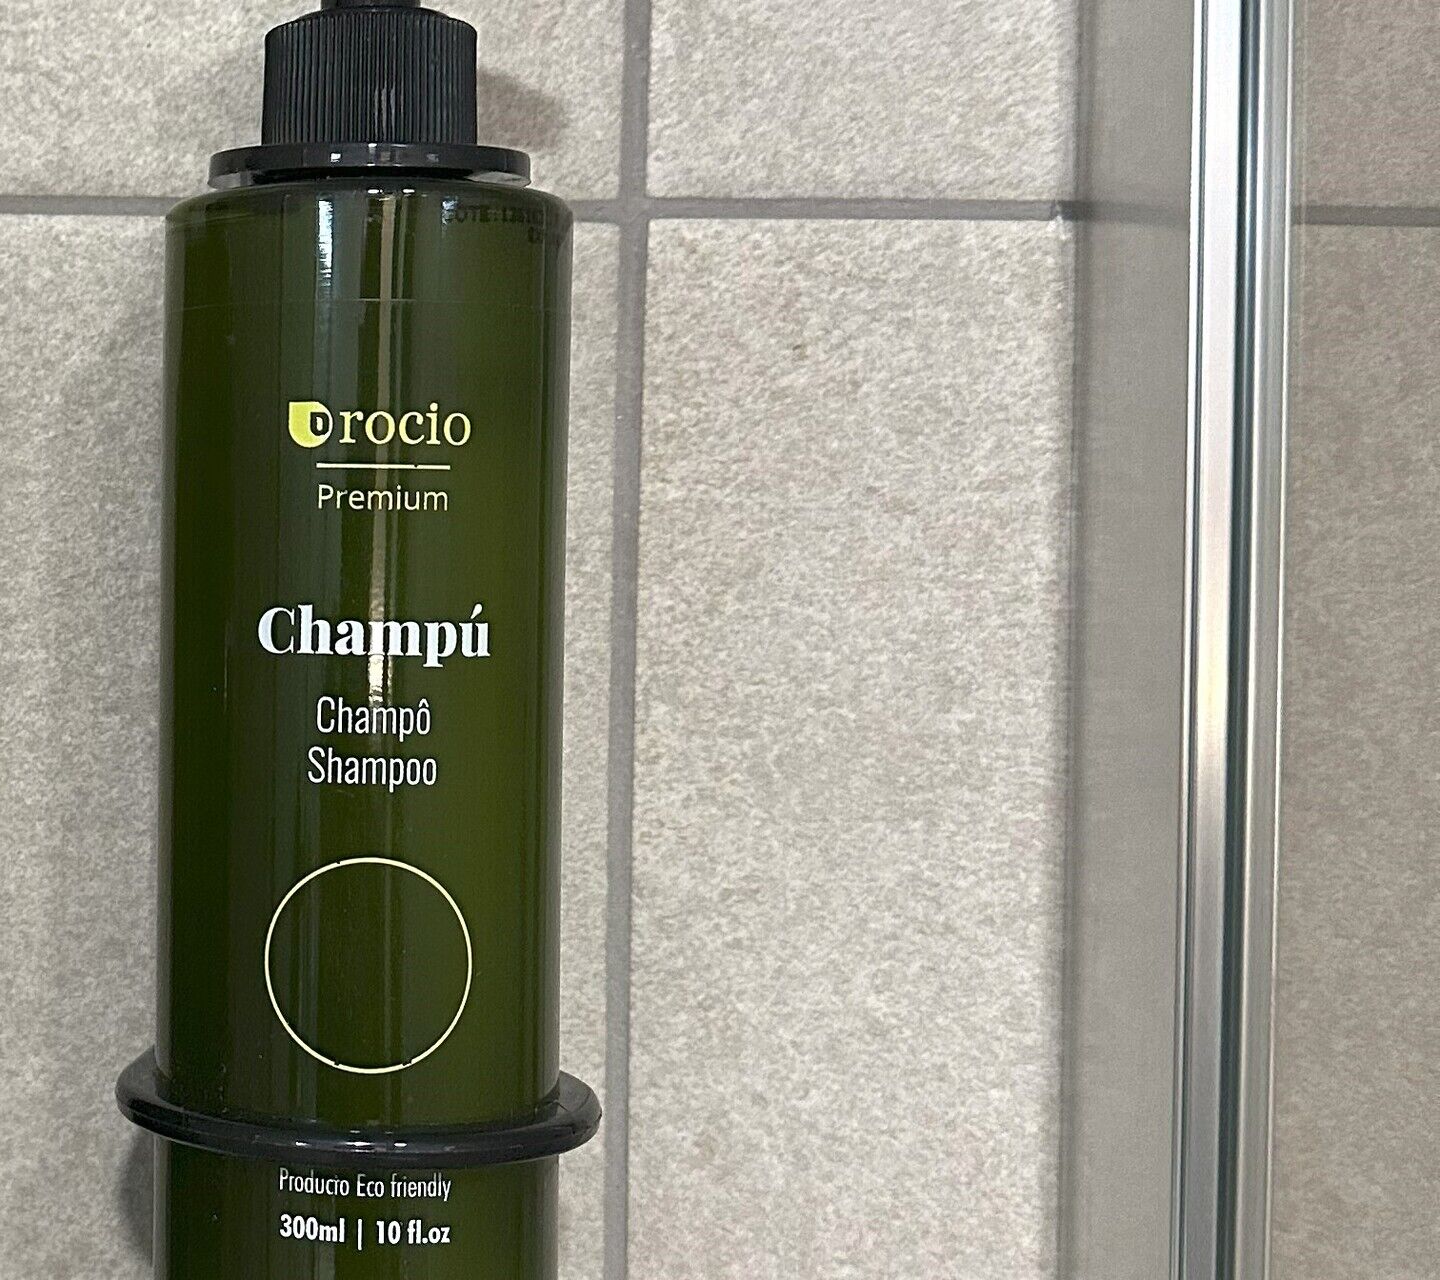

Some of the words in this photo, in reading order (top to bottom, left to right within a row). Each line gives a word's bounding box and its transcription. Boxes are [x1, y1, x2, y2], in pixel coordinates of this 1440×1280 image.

[317, 484, 449, 511] Premium
[257, 603, 491, 668] Champú
[316, 694, 431, 742] Champô
[307, 745, 437, 794] Shampoo
[356, 1173, 385, 1198] Eco
[390, 1172, 452, 1202] friendly
[279, 1213, 346, 1243] 300ml
[376, 1220, 401, 1245] 10
[406, 1219, 451, 1245] fl.oz
